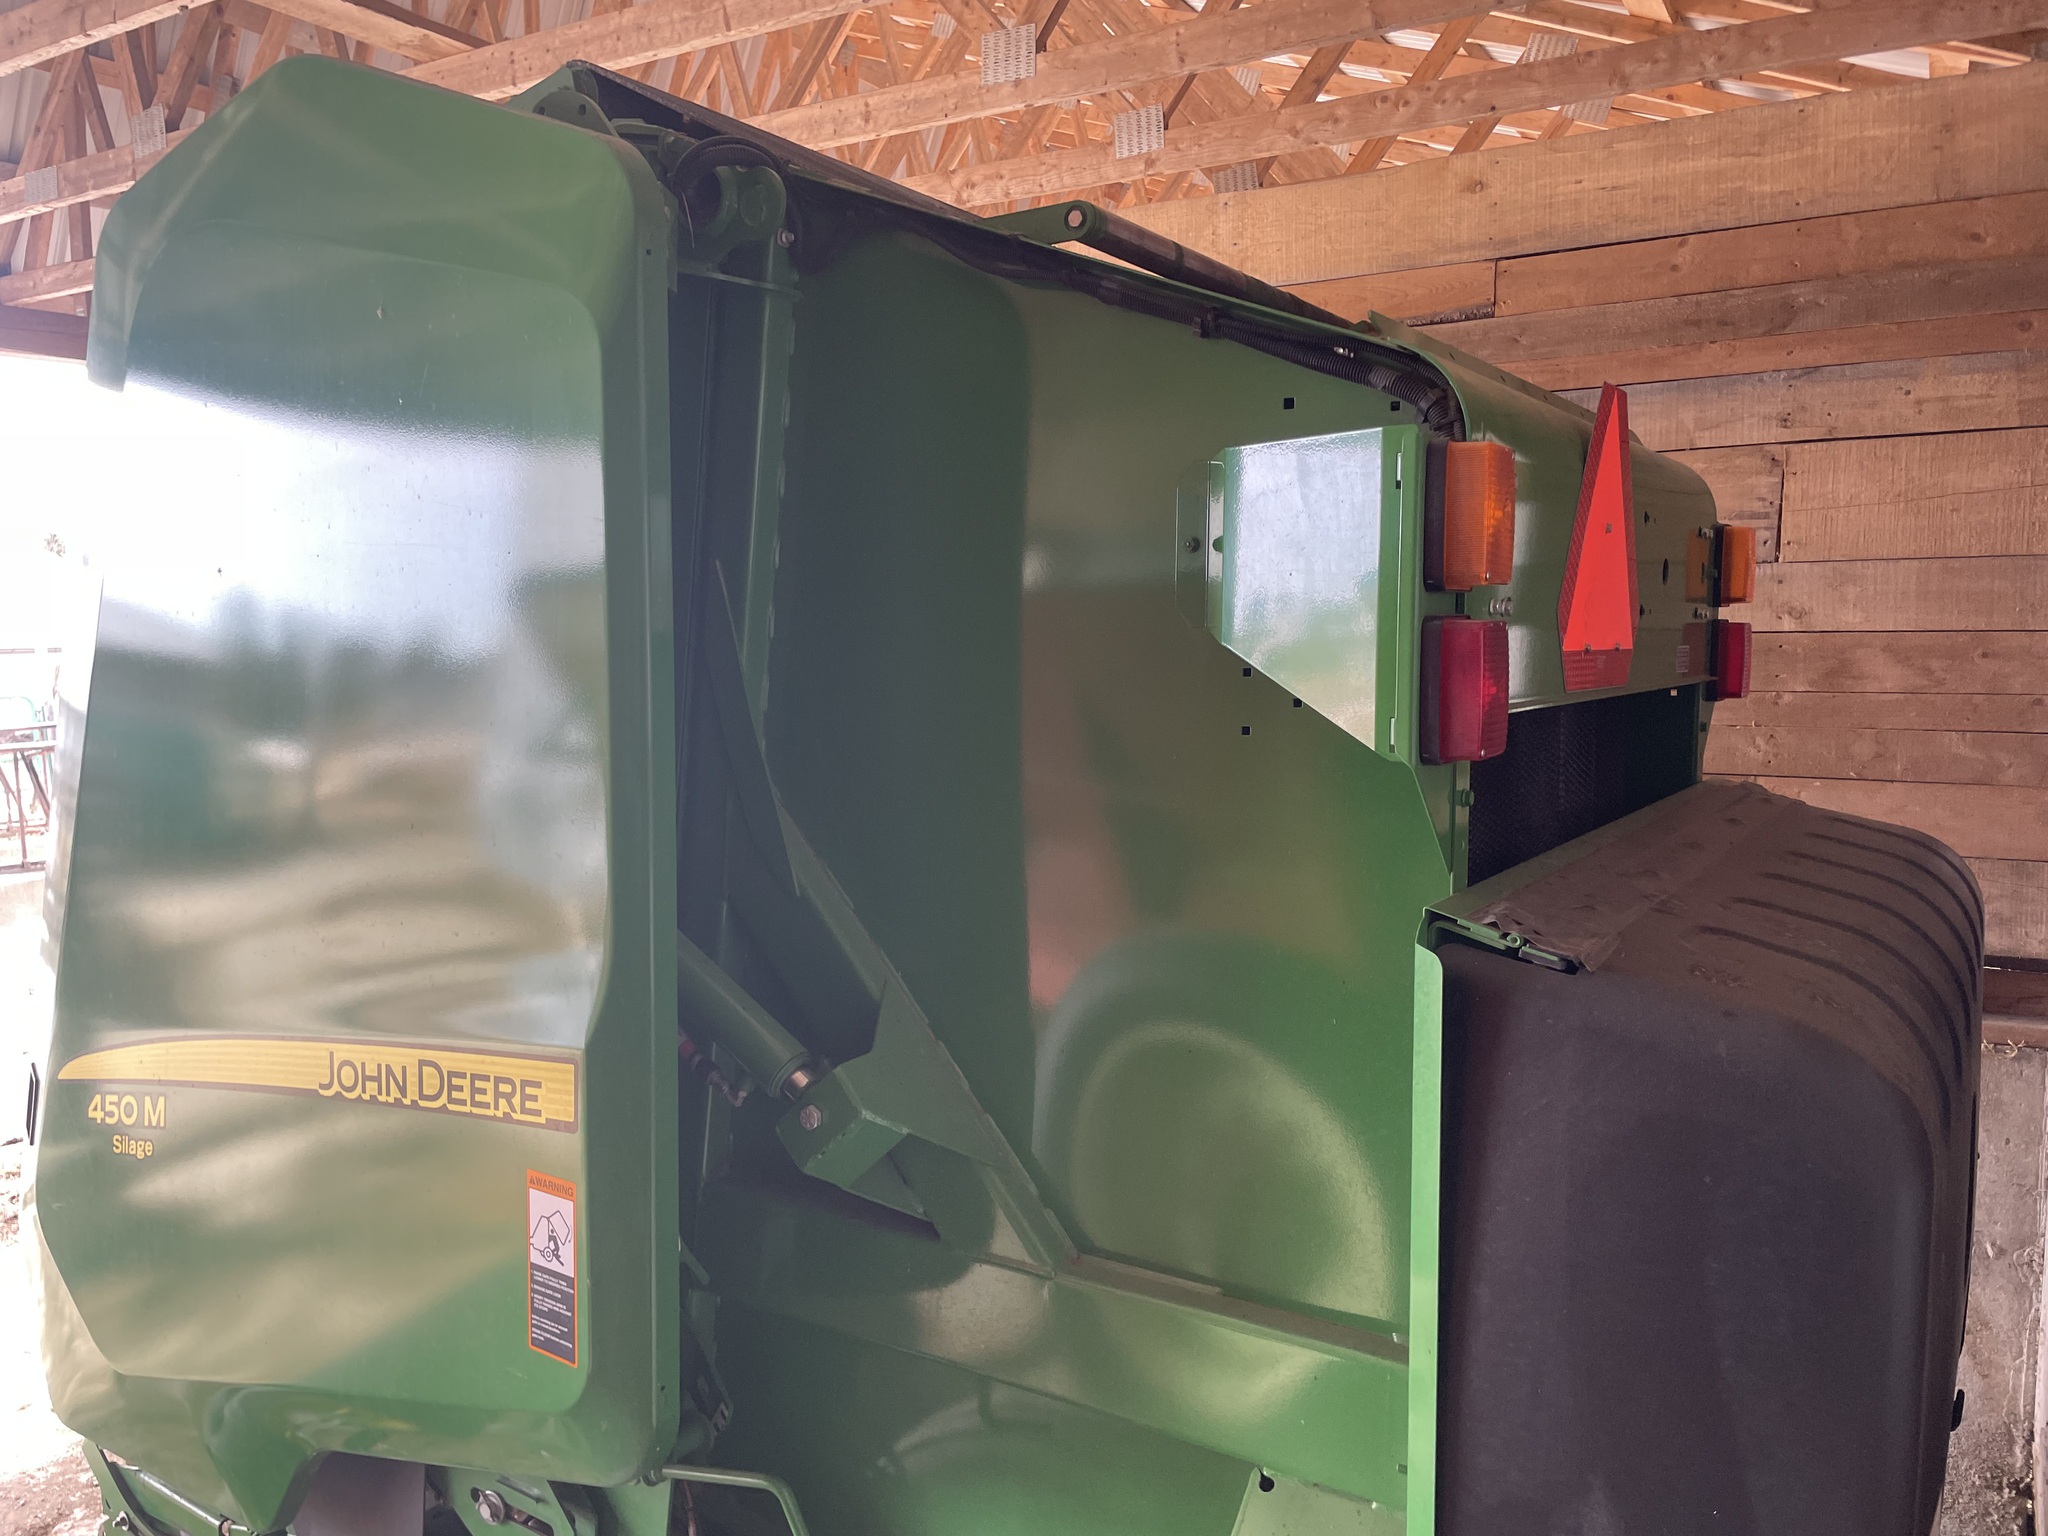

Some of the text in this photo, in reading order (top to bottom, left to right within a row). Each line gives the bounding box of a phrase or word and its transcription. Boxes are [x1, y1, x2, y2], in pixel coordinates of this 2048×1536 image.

[318, 1050, 544, 1119] JOHN DEERE
[87, 1093, 165, 1127] 450 M
[112, 1134, 153, 1160] Silage
[534, 1176, 574, 1197] WARNING
